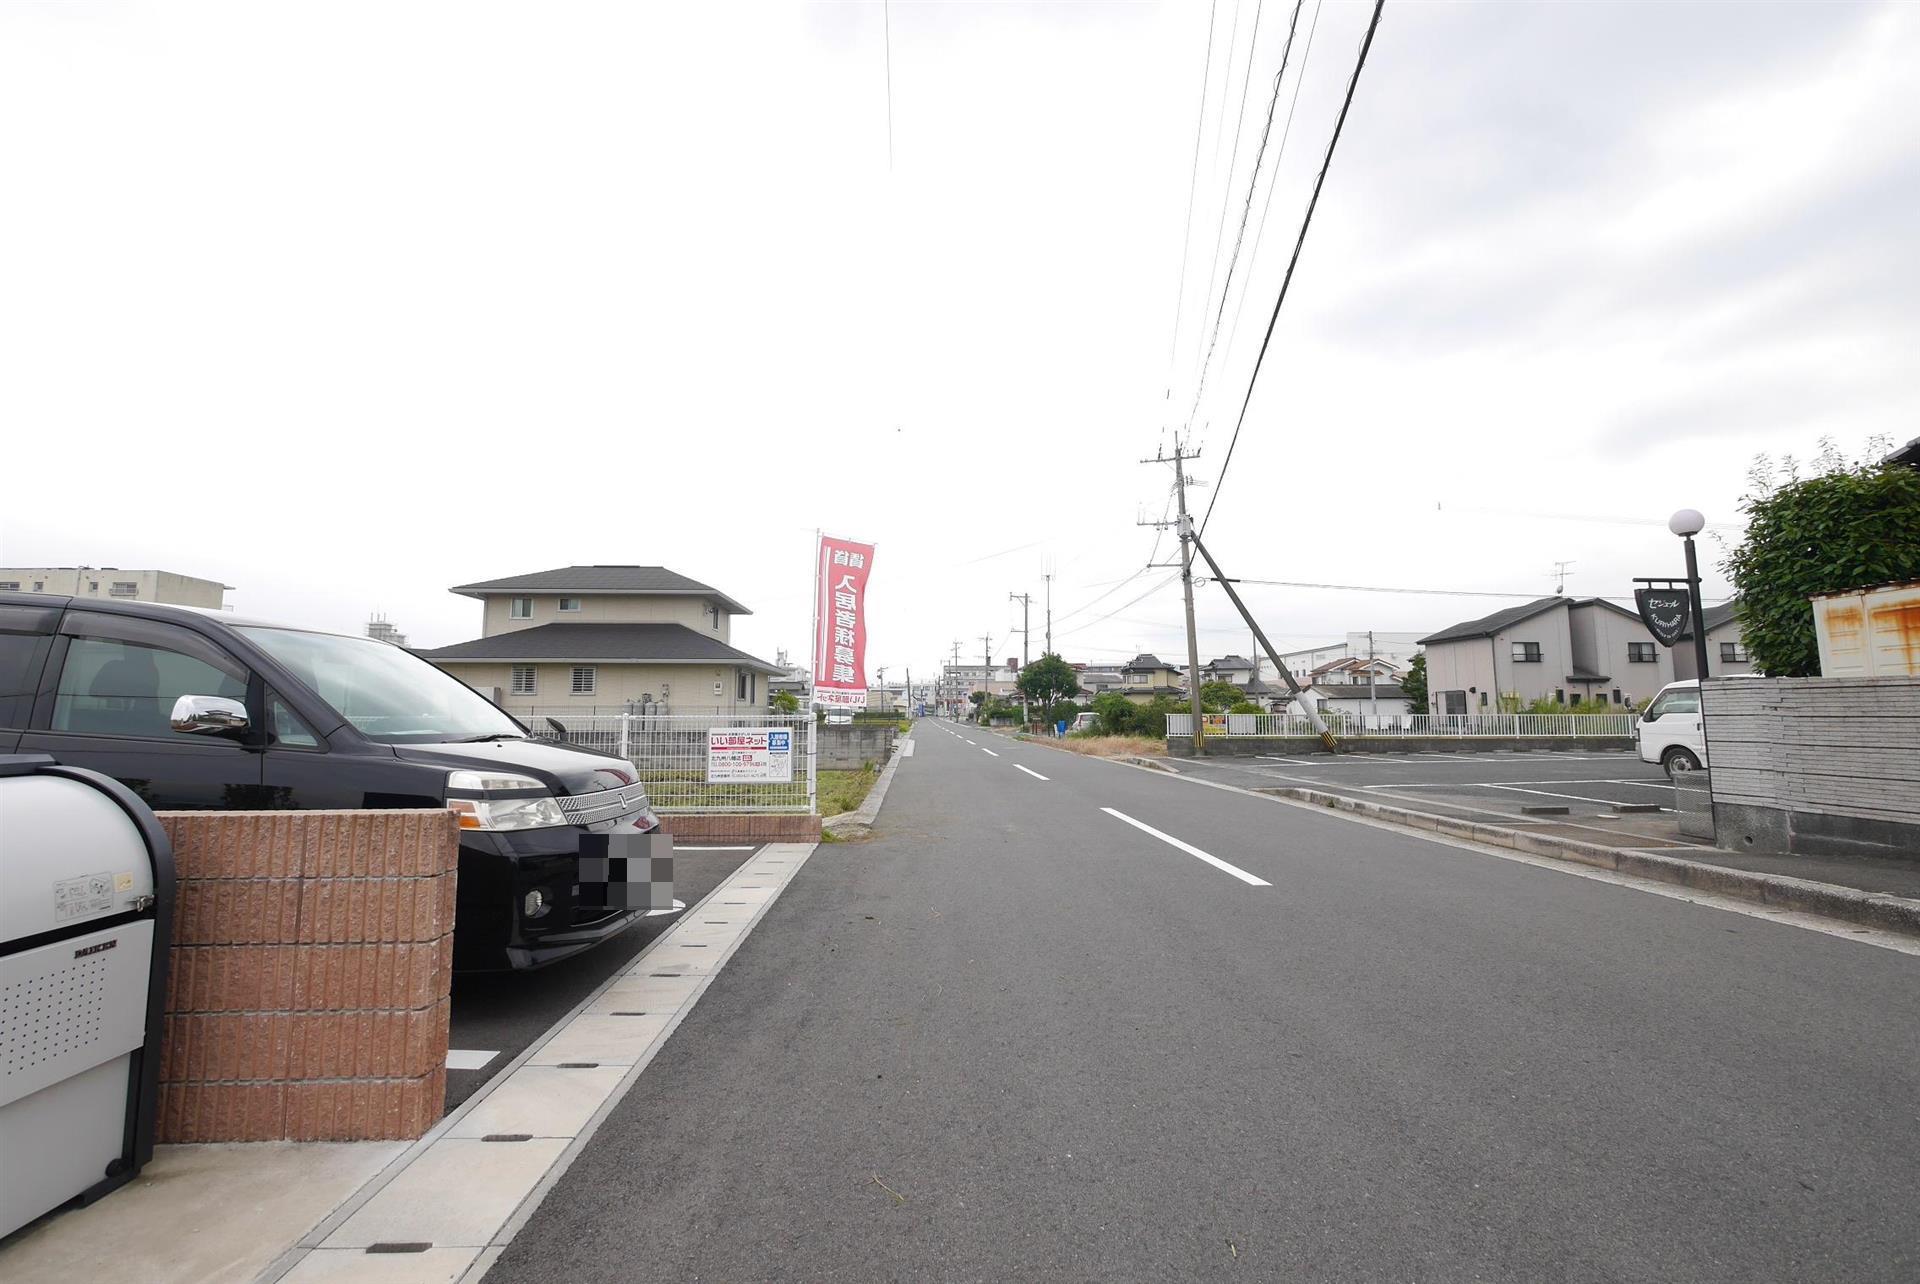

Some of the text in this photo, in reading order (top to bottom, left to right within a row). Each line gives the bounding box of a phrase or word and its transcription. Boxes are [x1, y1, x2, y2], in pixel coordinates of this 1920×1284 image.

[1650, 613, 1682, 628] KURIHARA
[711, 736, 767, 745] いい部屋ネット
